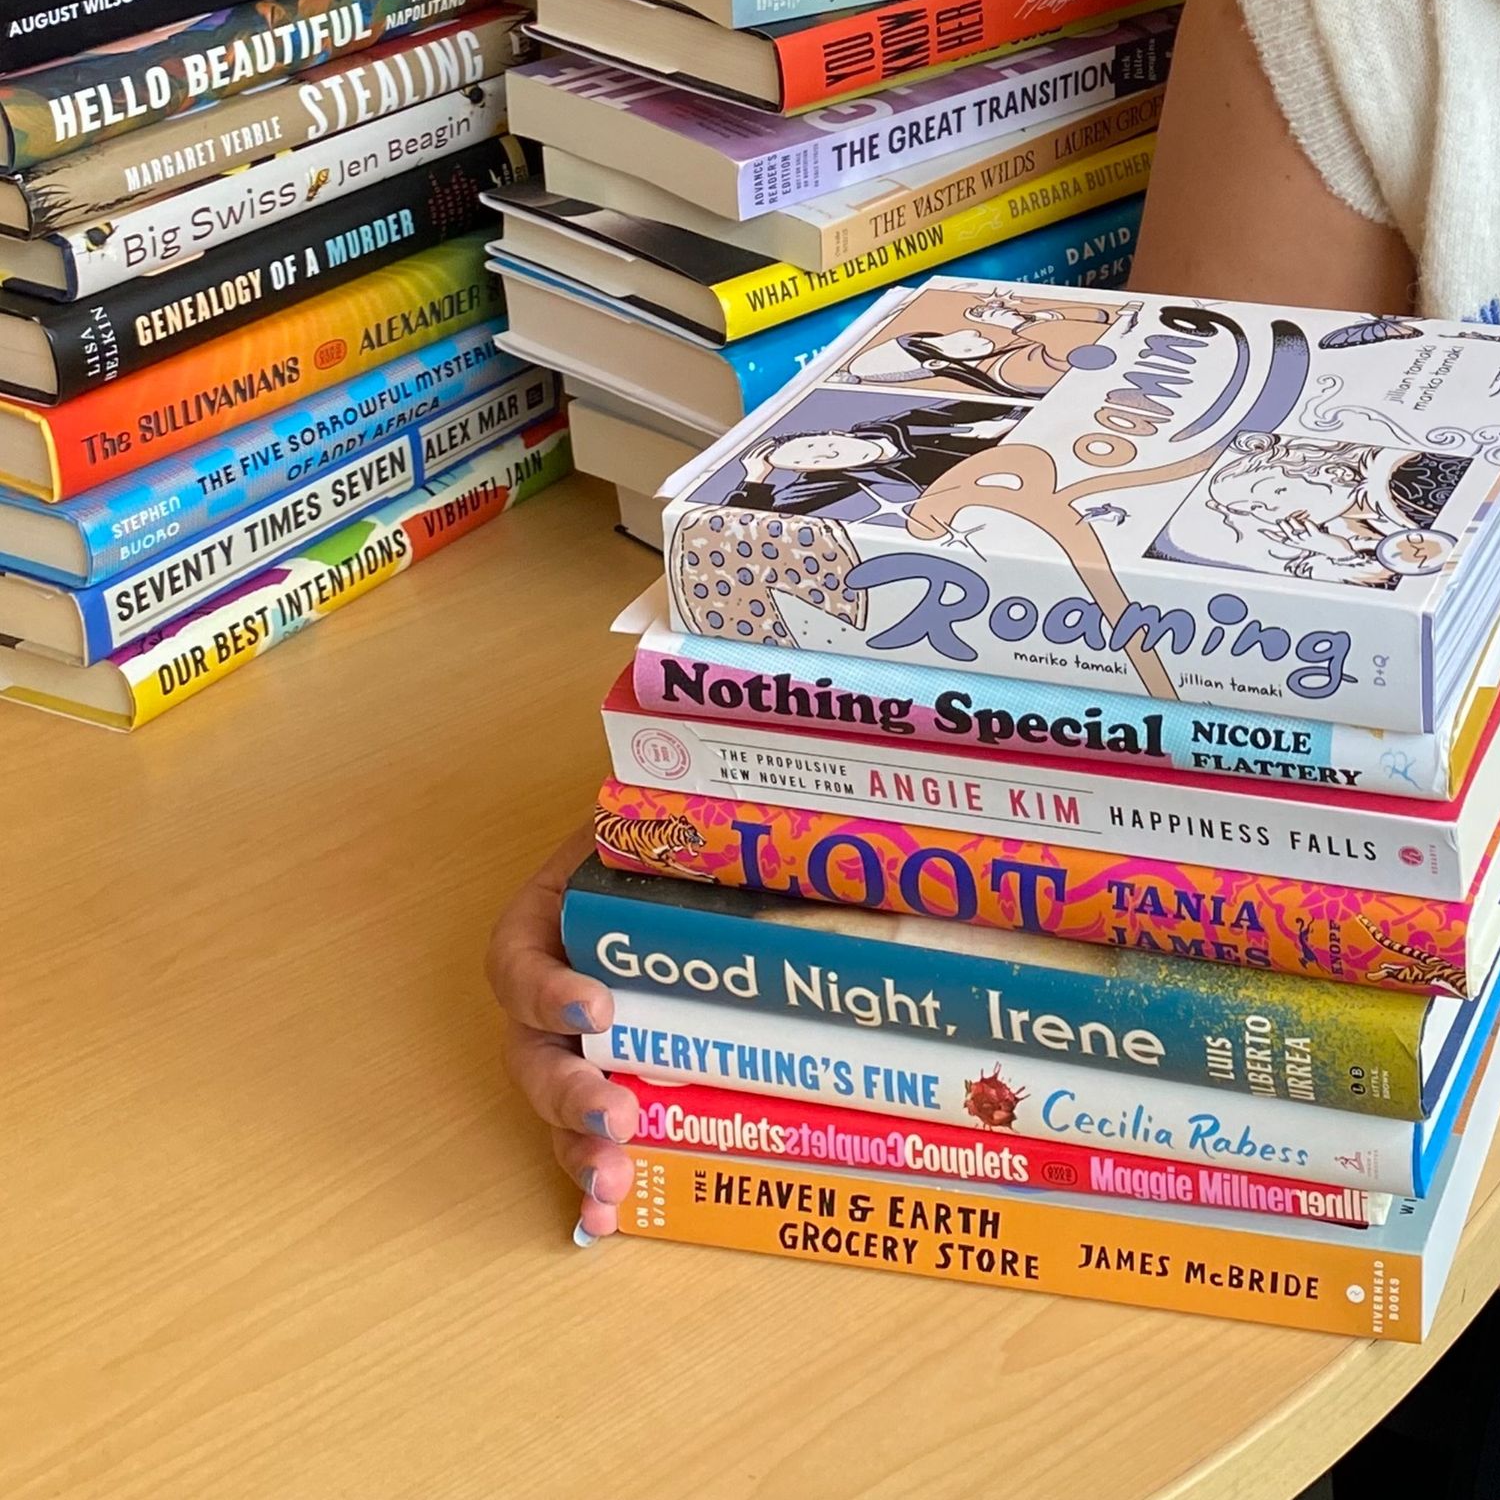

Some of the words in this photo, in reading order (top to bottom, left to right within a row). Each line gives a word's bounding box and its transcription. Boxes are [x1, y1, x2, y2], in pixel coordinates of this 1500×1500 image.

[9, 3, 80, 38] AUGUST
[48, 65, 172, 143] HELLO
[184, 1, 373, 98] BEAUTIFUL
[124, 139, 219, 192] MARGARET
[222, 117, 283, 159] VERBLE
[299, 29, 485, 140] STEALING
[832, 136, 881, 171] THE
[887, 109, 969, 153] GREAT
[973, 62, 1115, 126] TRANSITION
[122, 225, 181, 268] Big
[191, 180, 297, 241] Swiss
[337, 149, 378, 185] Jen
[388, 113, 472, 162] Beagin
[754, 160, 764, 205] ADVANCE
[782, 155, 791, 195] EDITION
[135, 269, 263, 348] GENEALOGY
[270, 257, 298, 290] OF
[304, 248, 320, 277] A
[325, 208, 416, 269] MURDER
[81, 326, 100, 379] LISA
[90, 304, 118, 382] BELKIN
[116, 537, 235, 622] SEVENTY
[243, 497, 323, 556] TIMES
[330, 447, 407, 508] SEVEN
[425, 419, 474, 465] ALEX
[476, 396, 520, 438] MAR
[157, 648, 209, 696] OUR
[212, 607, 273, 665] BEST
[276, 528, 407, 625] INTENTIONS
[423, 477, 501, 539] VIBHUTI
[504, 450, 544, 493] JAIN
[844, 553, 1357, 698] Roaming
[1013, 650, 1068, 668] mariko
[1074, 655, 1128, 675] tamaki
[1178, 673, 1224, 689] jillian
[1230, 675, 1283, 698] tamaki
[661, 658, 915, 734] Nothing
[933, 692, 1169, 758] Special
[1192, 720, 1312, 754] NICOLE
[721, 749, 748, 763] THE
[757, 753, 847, 776] PROPULSIVE
[721, 767, 750, 782] NEW
[760, 771, 806, 789] NOVEL
[815, 779, 855, 796] FROM
[870, 769, 984, 812] ANGIE
[1010, 787, 1082, 826] KIM
[1110, 806, 1270, 846] HAPPINESS
[1290, 831, 1377, 861] FALLS
[729, 818, 1068, 936] LOOT
[1107, 879, 1265, 933] TANIA
[596, 932, 760, 998] Good
[784, 958, 958, 1036] Night,
[985, 989, 1166, 1067] Irene
[612, 1024, 854, 1095] EVERYTHING'S
[863, 1066, 942, 1110] FINE
[1042, 1089, 1175, 1150] Cecilia
[1188, 1113, 1309, 1167] Rabess
[694, 1170, 707, 1203] THE
[714, 1172, 836, 1218] HEAVEN
[849, 1195, 875, 1223] &
[889, 1196, 1001, 1239] EARTH
[779, 1222, 918, 1265] GROCERY
[936, 1242, 1040, 1280] STORE
[1079, 1243, 1171, 1277] JAMES
[1185, 1261, 1320, 1300] McBRIDE
[1373, 1260, 1384, 1333] RIVERHEAD
[1389, 1277, 1400, 1321] BOOKS
